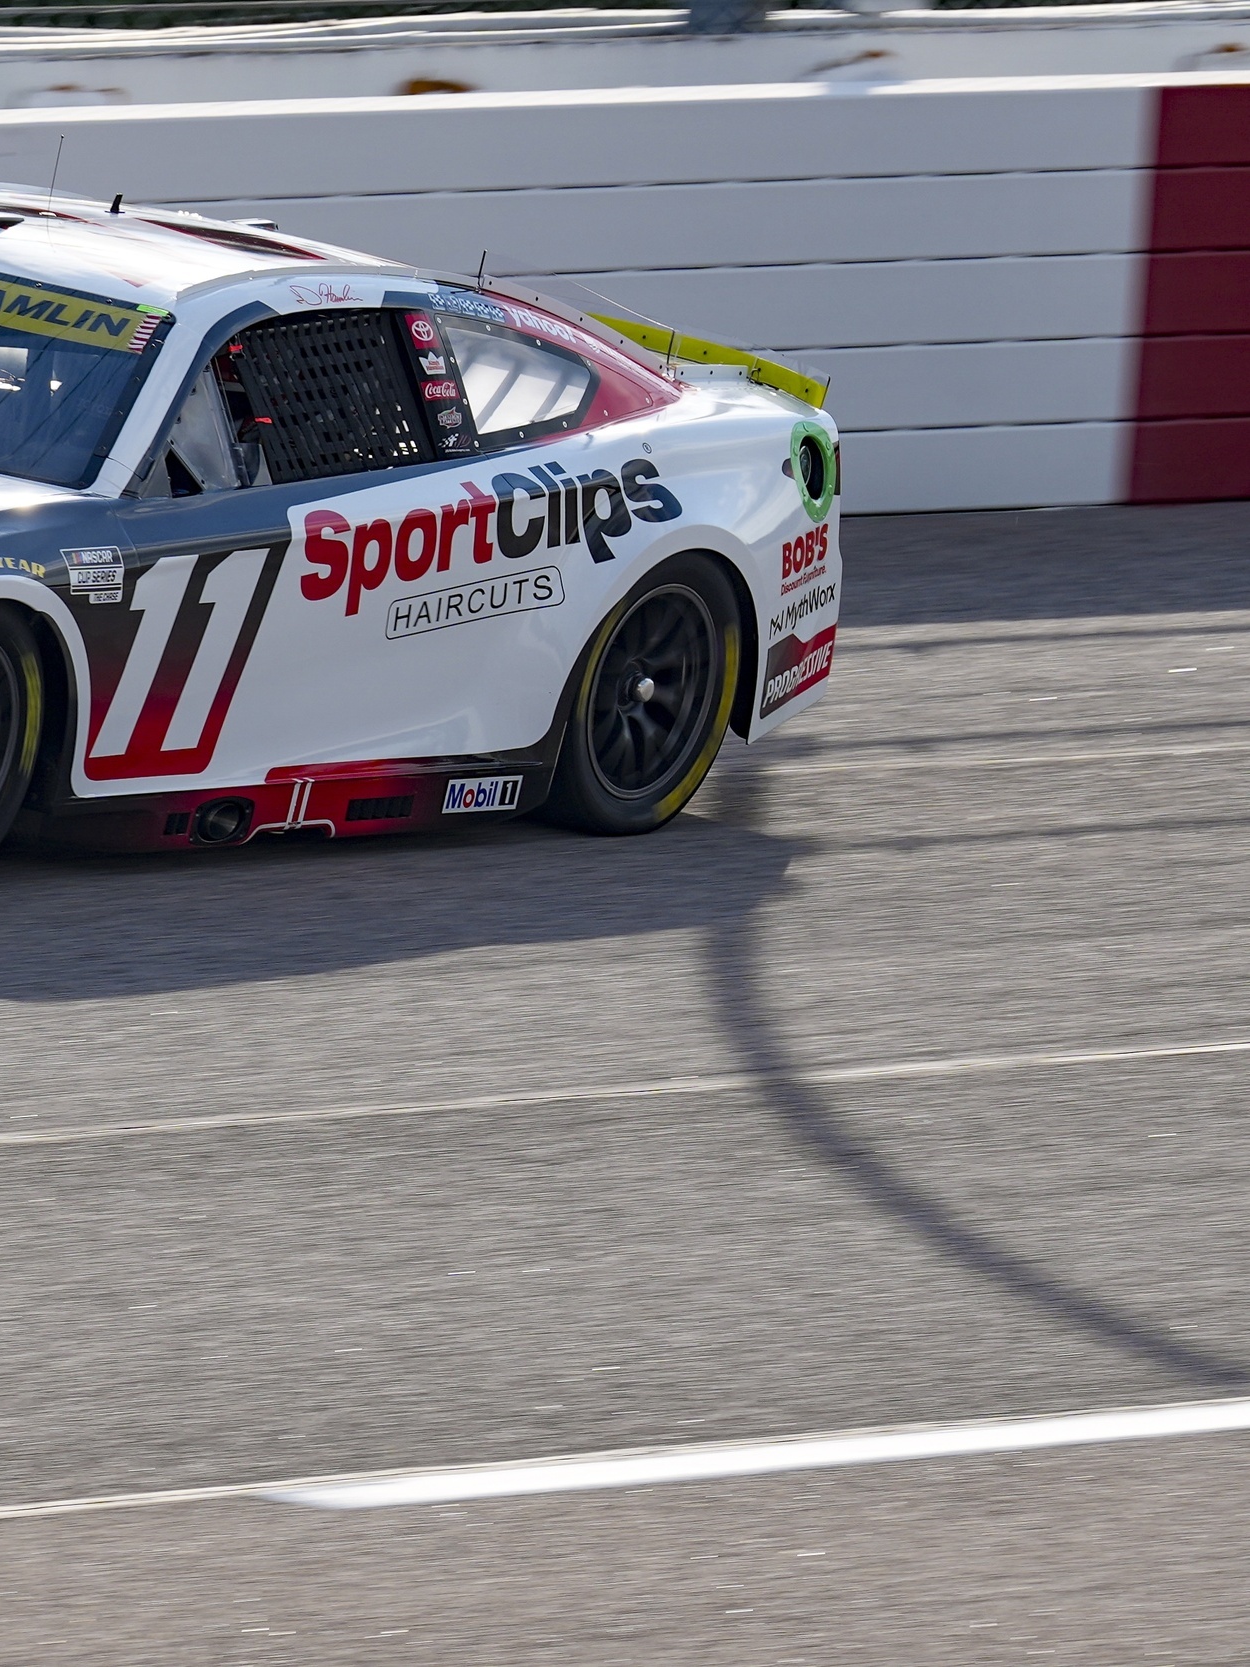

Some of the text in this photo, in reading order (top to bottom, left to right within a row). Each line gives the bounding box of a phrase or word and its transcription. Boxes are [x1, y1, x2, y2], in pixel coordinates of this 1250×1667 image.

[503, 303, 577, 344] yahoo!
[80, 550, 114, 564] NASCAR
[781, 523, 829, 580] BOB'S
[392, 573, 555, 633] HAIRCUTS
[784, 582, 836, 630] MythWorx
[90, 548, 272, 760] 11
[762, 641, 834, 709] PROGRESSIVE
[445, 781, 499, 809] Mobil
